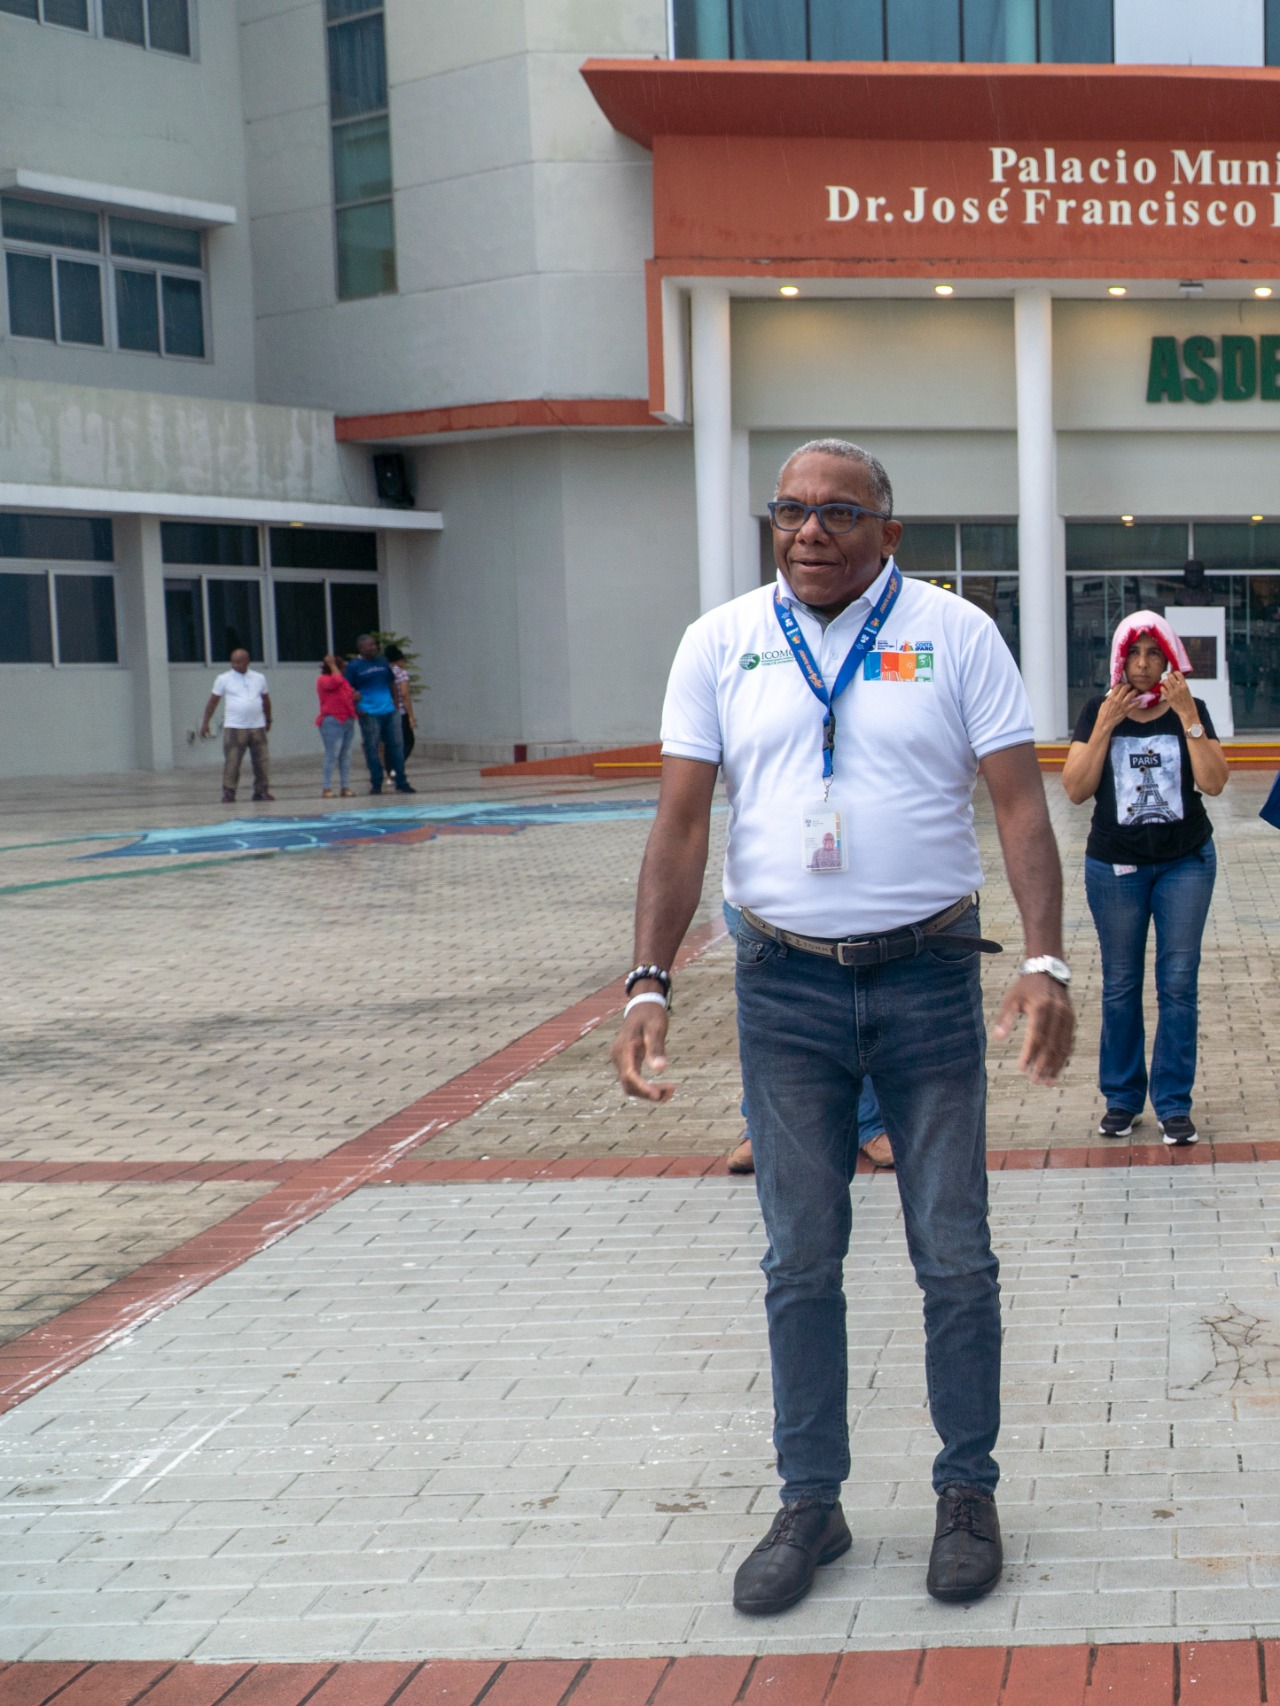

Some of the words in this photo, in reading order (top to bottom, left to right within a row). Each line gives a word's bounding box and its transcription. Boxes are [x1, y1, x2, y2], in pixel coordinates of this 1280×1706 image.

[989, 147, 1157, 184] Palacio
[825, 185, 894, 222] Dr.
[903, 187, 1009, 224] José
[1022, 189, 1257, 227] Francisco
[1132, 756, 1159, 766] PARIS
